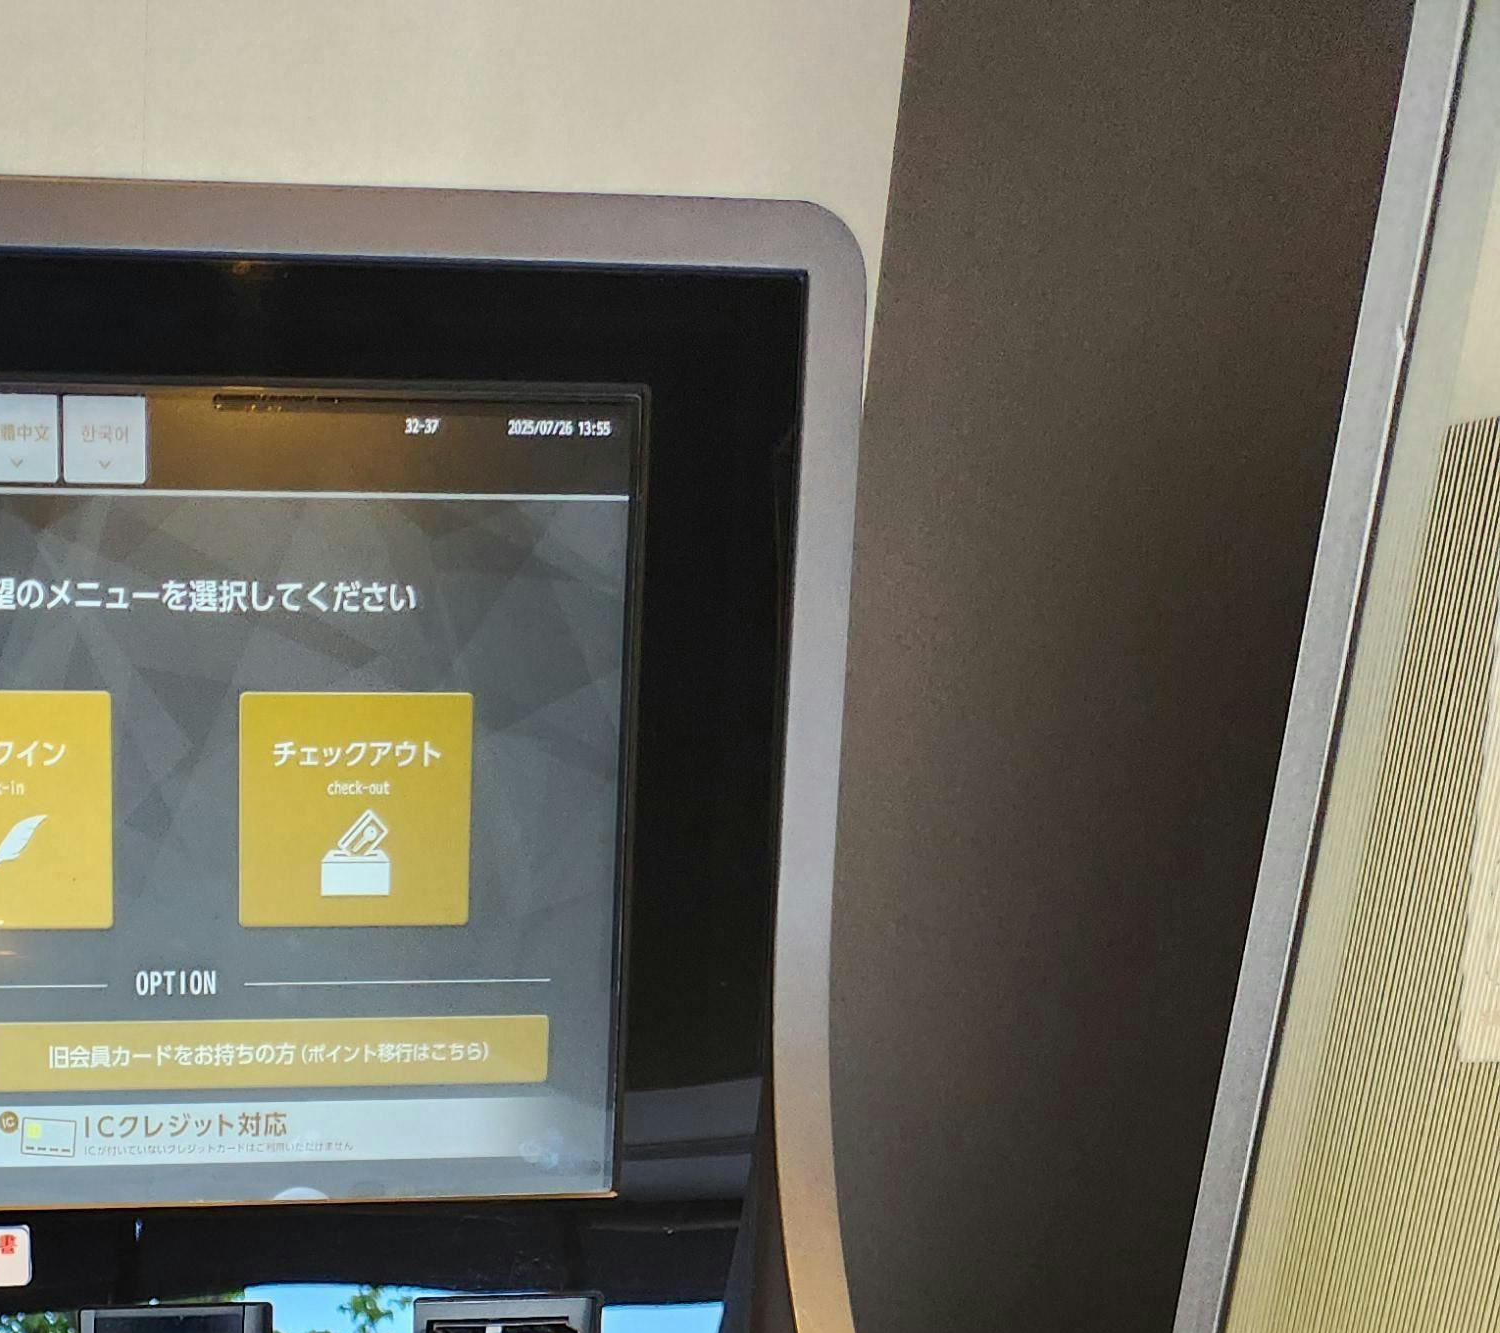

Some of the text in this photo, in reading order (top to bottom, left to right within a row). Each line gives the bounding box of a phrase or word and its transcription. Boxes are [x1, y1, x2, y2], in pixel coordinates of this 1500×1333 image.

[80, 424, 131, 445] 한국어
[404, 417, 440, 435] 32-37
[507, 419, 613, 437] 2025/07/26 13:55
[272, 740, 443, 768] チェックアウト
[327, 779, 390, 796] check-out
[135, 970, 217, 996] OPTION
[49, 1042, 295, 1070] 旧会員カードをお持ちの方
[85, 1112, 288, 1138] ICクレジット対応
